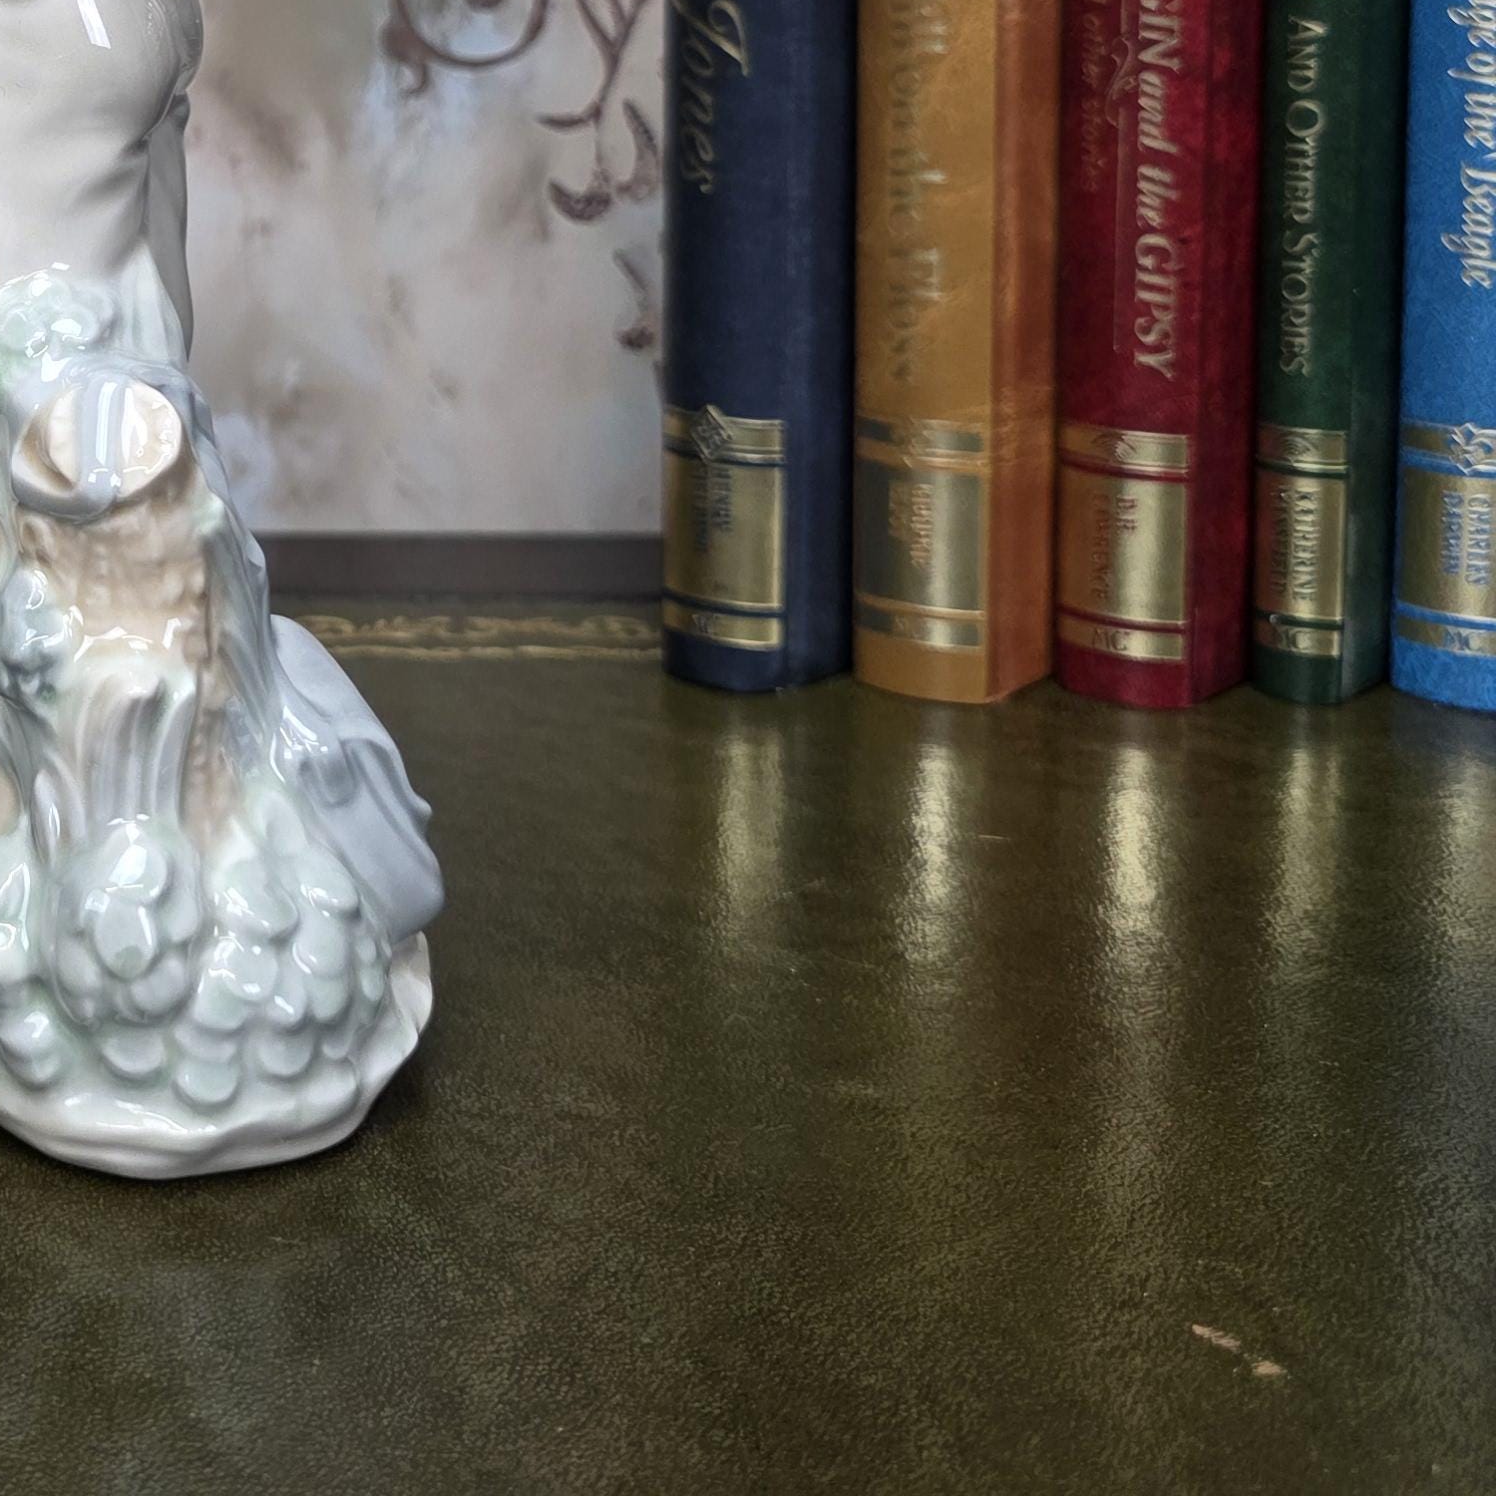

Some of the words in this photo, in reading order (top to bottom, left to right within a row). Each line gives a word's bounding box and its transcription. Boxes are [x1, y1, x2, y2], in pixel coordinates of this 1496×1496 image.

[1138, 69, 1180, 153] and
[1447, 51, 1496, 88] of
[1463, 92, 1496, 149] the
[888, 144, 947, 237] the
[1135, 163, 1180, 230] the
[1133, 233, 1182, 380] GIPSY
[1293, 486, 1322, 602] KATHERINE
[1440, 489, 1465, 576] DARWIN
[1464, 493, 1492, 587] CHARLES
